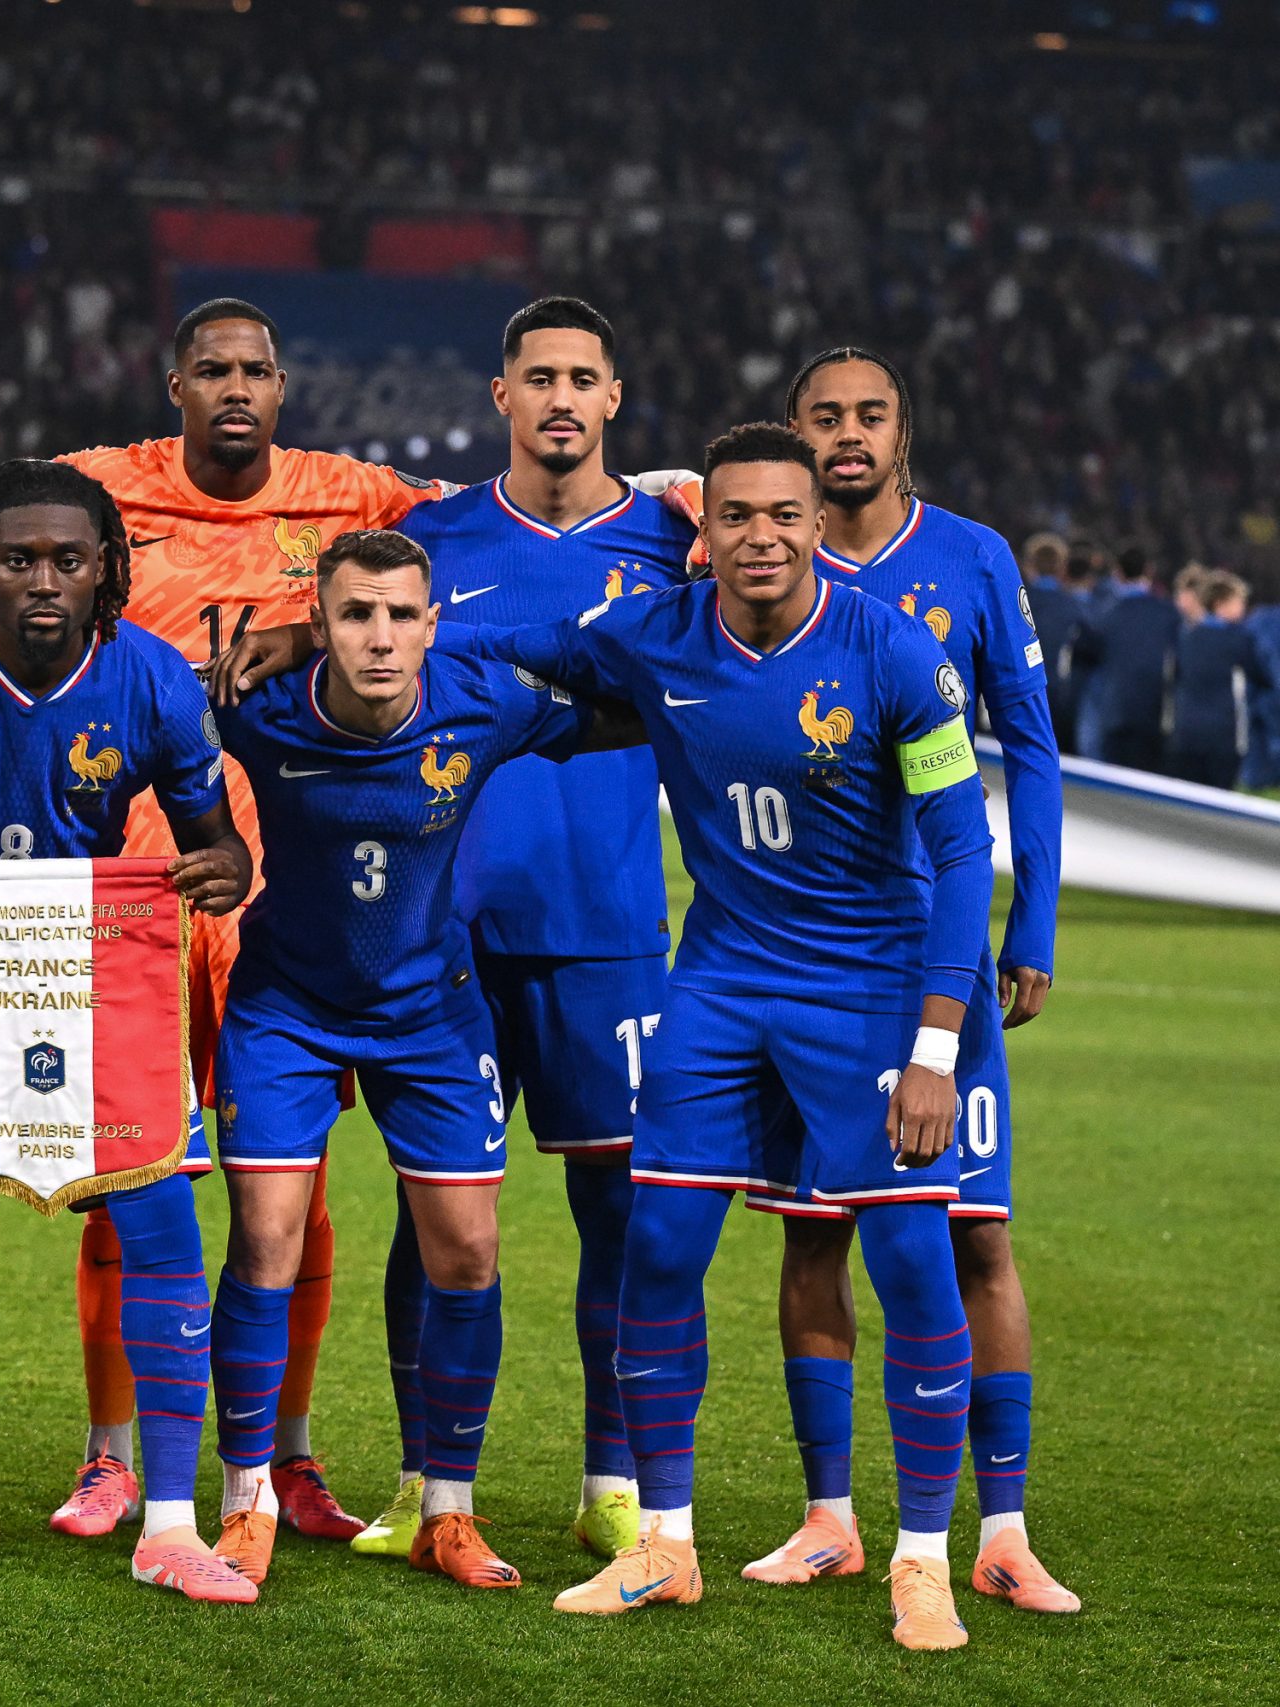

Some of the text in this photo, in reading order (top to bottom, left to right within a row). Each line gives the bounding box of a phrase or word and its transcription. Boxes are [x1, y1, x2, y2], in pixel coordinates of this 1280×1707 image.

[921, 744, 967, 769] RESPECT
[727, 782, 793, 852] 10
[0, 823, 34, 860] 8
[352, 840, 387, 901] 3
[47, 905, 66, 919] DE
[69, 904, 86, 918] LA
[91, 903, 117, 919] FIFA
[120, 903, 154, 917] 2026
[478, 1053, 505, 1124] 3
[90, 1124, 143, 1139] 2025
[18, 1144, 76, 1159] PARIS
